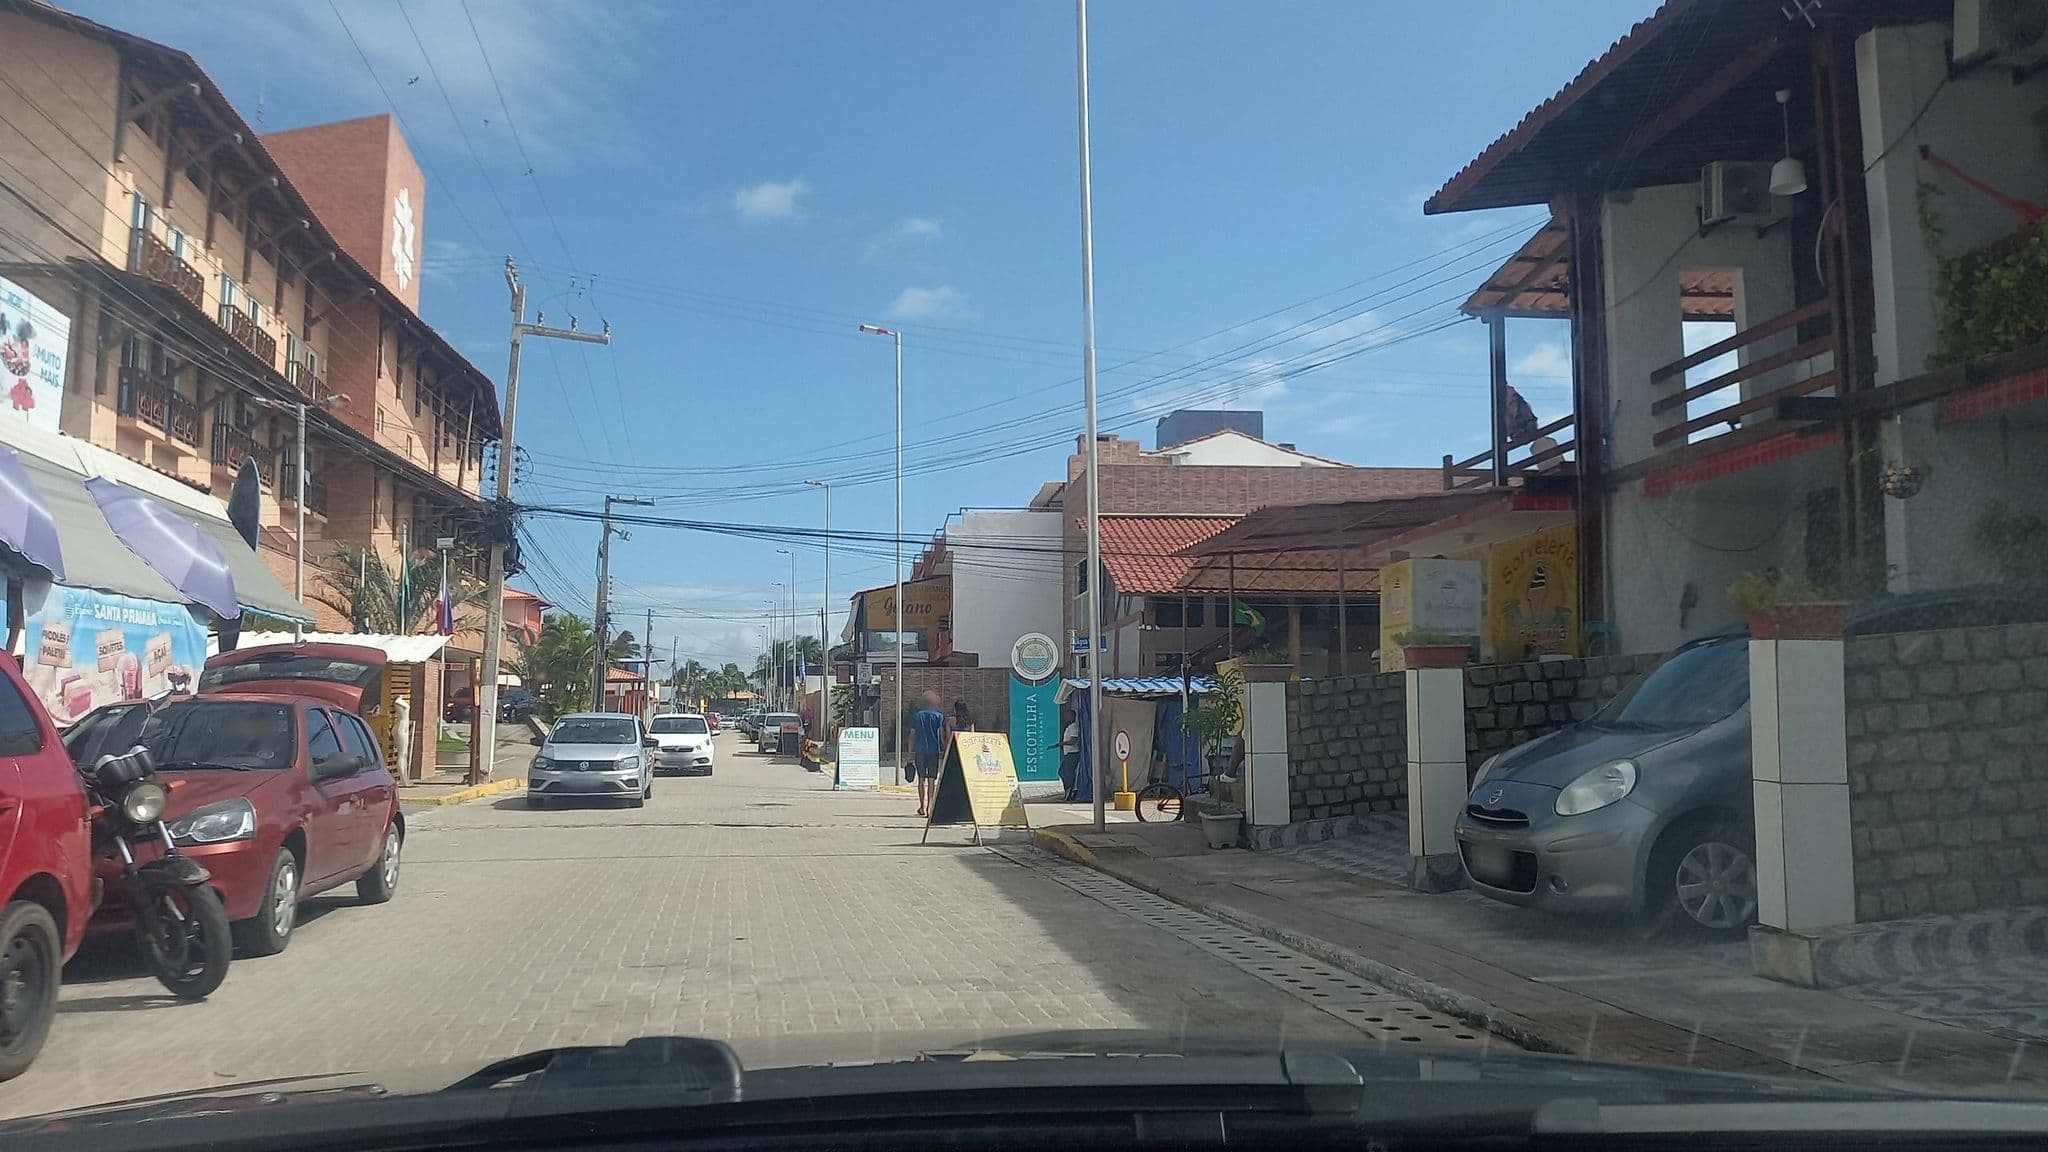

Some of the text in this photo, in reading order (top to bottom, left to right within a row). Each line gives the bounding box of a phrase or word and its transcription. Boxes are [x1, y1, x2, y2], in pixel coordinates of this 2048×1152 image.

[36, 345, 61, 370] MUITO
[40, 367, 60, 388] MAIS
[1503, 536, 1575, 585] Sorveteria
[94, 603, 121, 623] SANTA
[844, 730, 874, 740] MENU
[1026, 693, 1037, 773] ESCOTILHA
